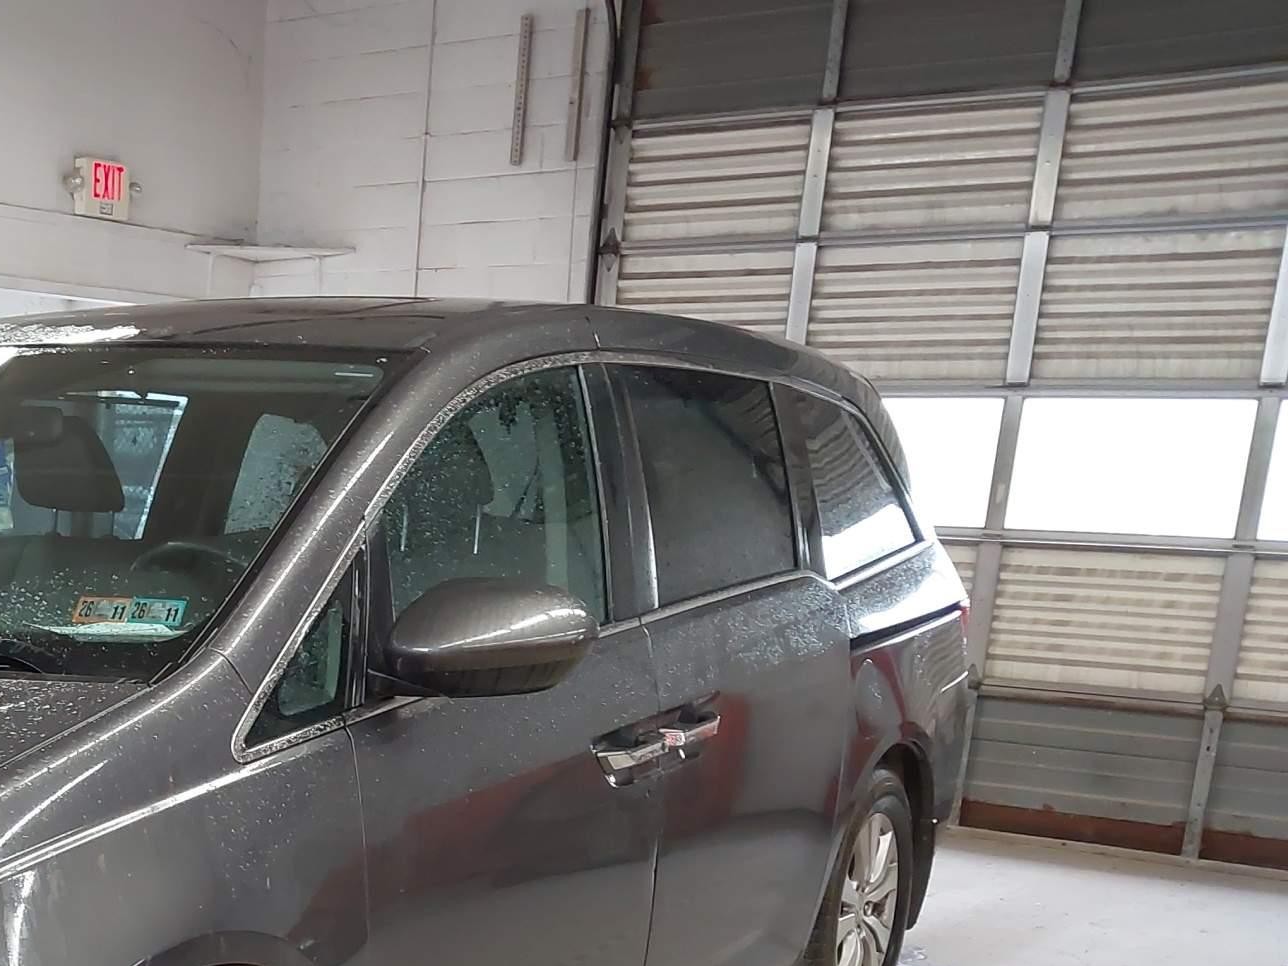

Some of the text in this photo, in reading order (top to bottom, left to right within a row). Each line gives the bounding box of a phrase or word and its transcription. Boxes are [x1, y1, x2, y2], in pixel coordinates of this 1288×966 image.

[93, 162, 125, 202] EXIT
[78, 600, 127, 620] 26 11
[131, 602, 180, 622] 26 11
